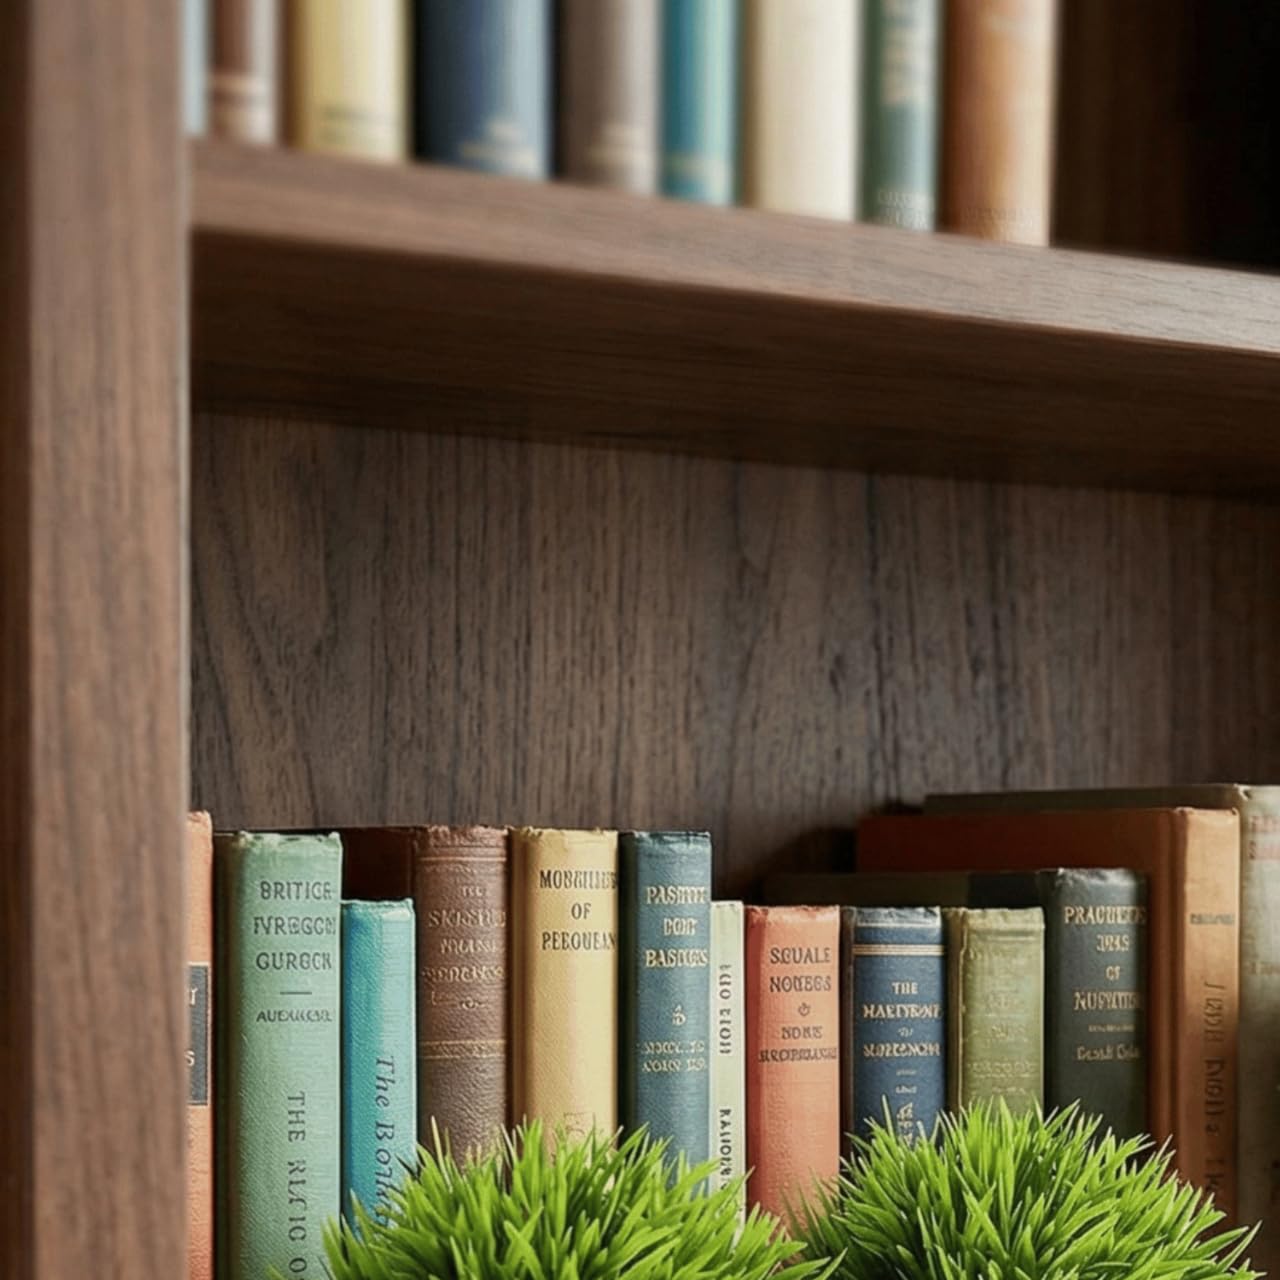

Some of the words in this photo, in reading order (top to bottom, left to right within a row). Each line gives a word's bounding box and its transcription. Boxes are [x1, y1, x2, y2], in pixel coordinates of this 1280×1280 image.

[571, 902, 591, 920] OF
[892, 981, 918, 995] THE
[376, 1055, 396, 1108] The
[288, 1092, 306, 1142] THE
